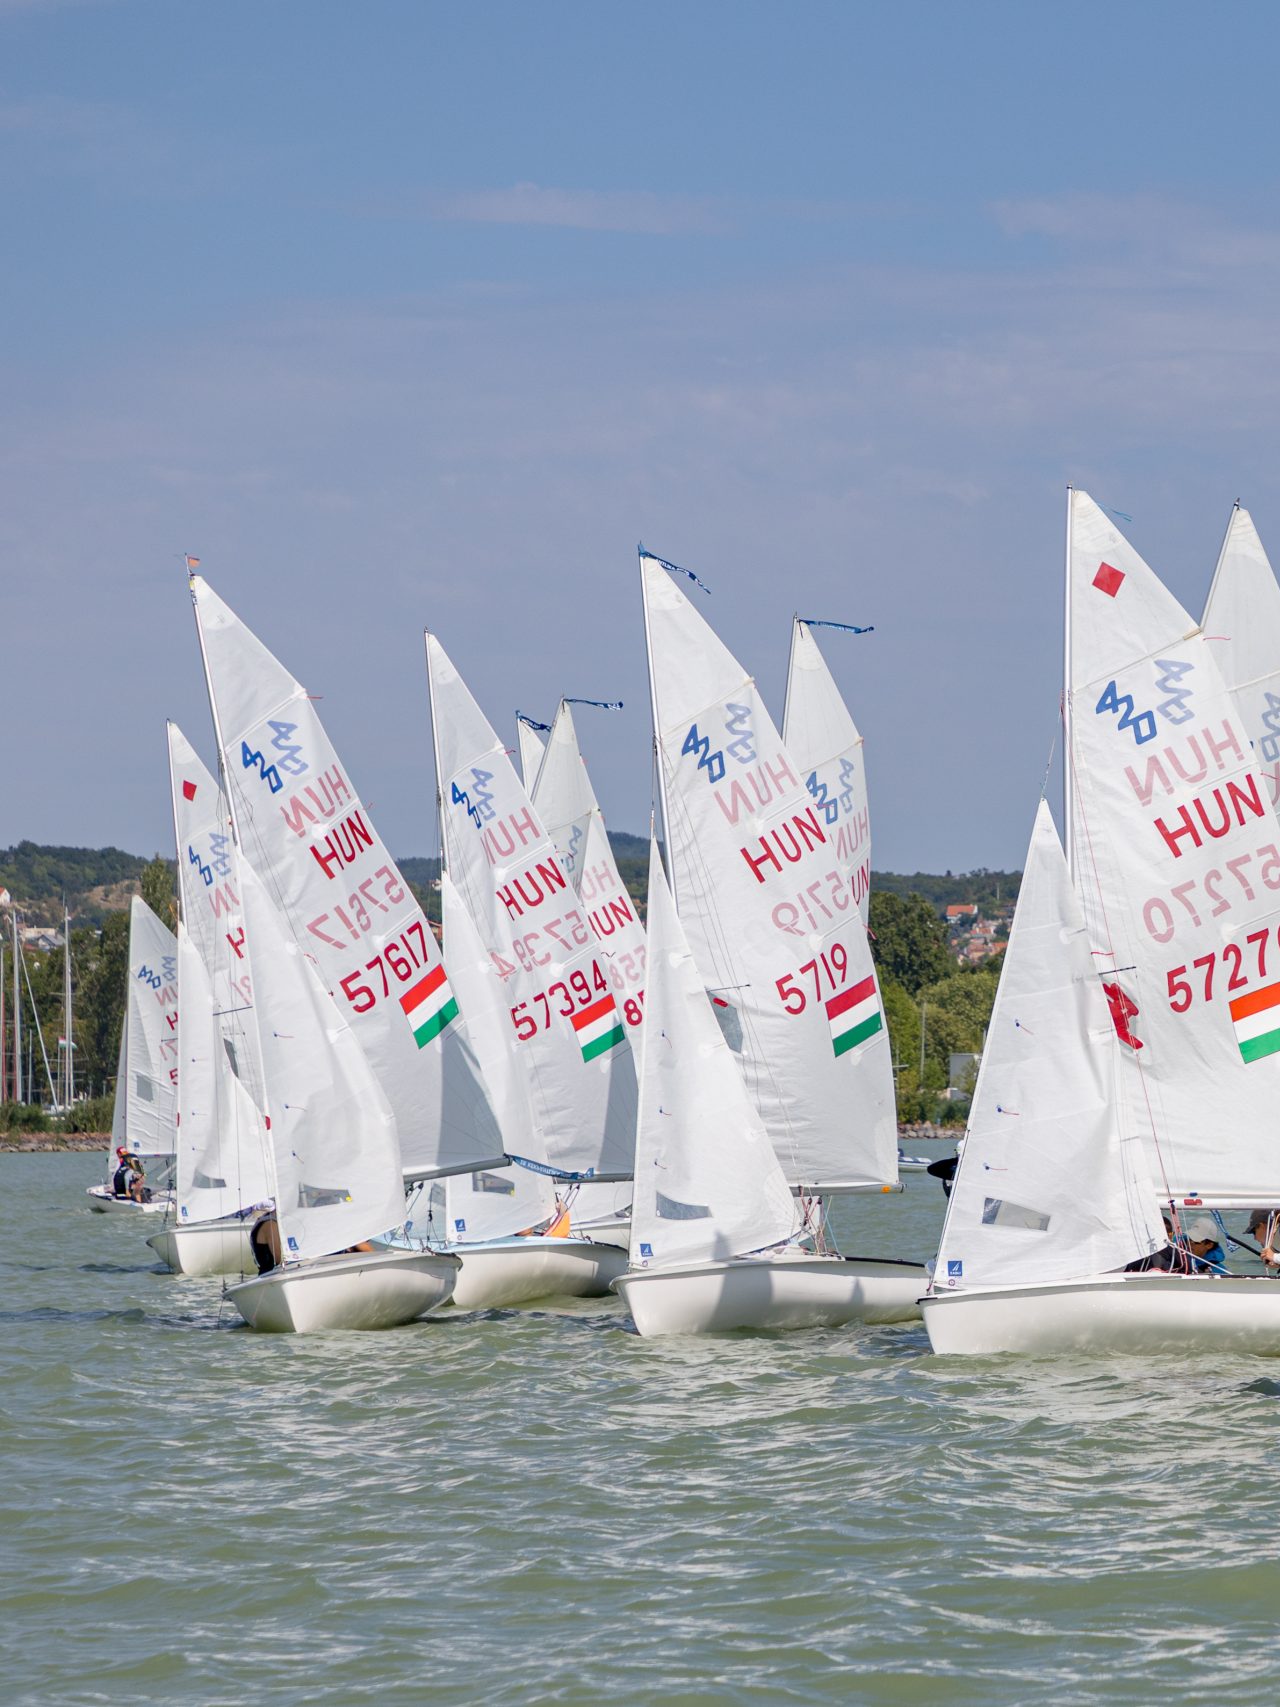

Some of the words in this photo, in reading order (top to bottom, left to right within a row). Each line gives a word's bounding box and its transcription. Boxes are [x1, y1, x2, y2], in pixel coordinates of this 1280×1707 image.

[1096, 679, 1158, 745] 420
[241, 740, 283, 794] 420
[681, 723, 726, 784] 420
[451, 781, 482, 830] 420
[805, 771, 838, 825] 420
[1153, 773, 1266, 858] HUN
[309, 810, 375, 880] HUN
[740, 806, 826, 884] HUN
[496, 857, 567, 921] HUN
[851, 858, 869, 906] UN
[588, 895, 634, 941] UN
[340, 921, 429, 1013] 57617
[775, 943, 848, 1016] 5719
[511, 959, 607, 1041] 57394
